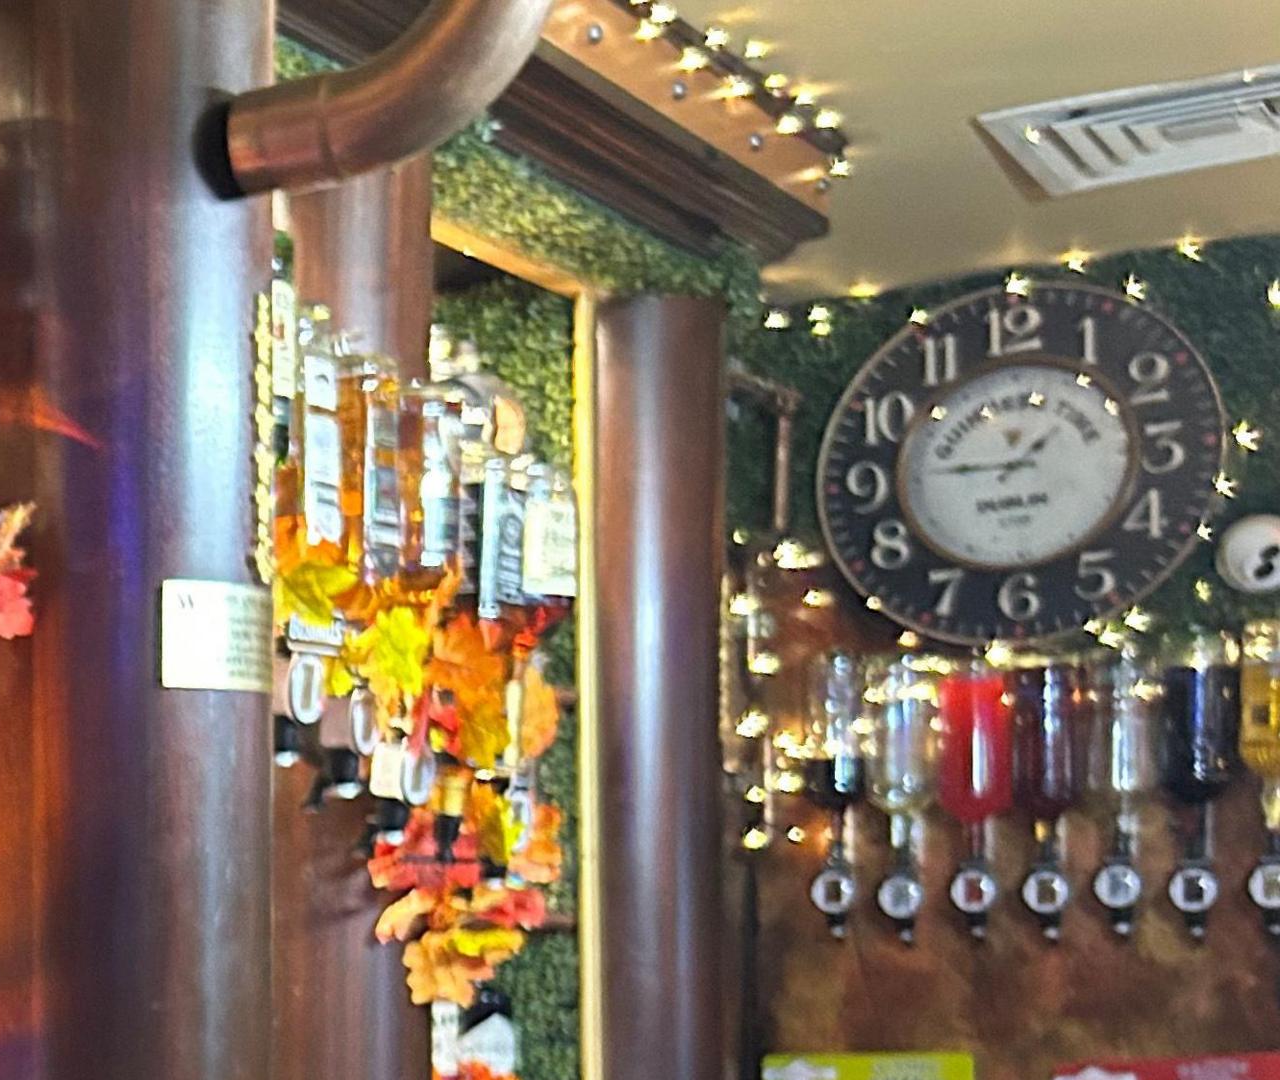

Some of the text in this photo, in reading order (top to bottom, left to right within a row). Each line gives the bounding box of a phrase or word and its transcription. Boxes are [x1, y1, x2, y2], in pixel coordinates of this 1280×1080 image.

[987, 305, 1044, 356] 12
[1079, 316, 1098, 364] 1
[922, 334, 958, 387] 11
[1128, 352, 1171, 403] 2
[860, 391, 915, 446] 10
[1141, 419, 1186, 474] 3
[846, 460, 888, 515] 9
[1123, 489, 1168, 540] 4
[872, 519, 912, 570] 8
[927, 569, 967, 618] 7
[998, 573, 1040, 622] 6
[1075, 550, 1116, 598] 5
